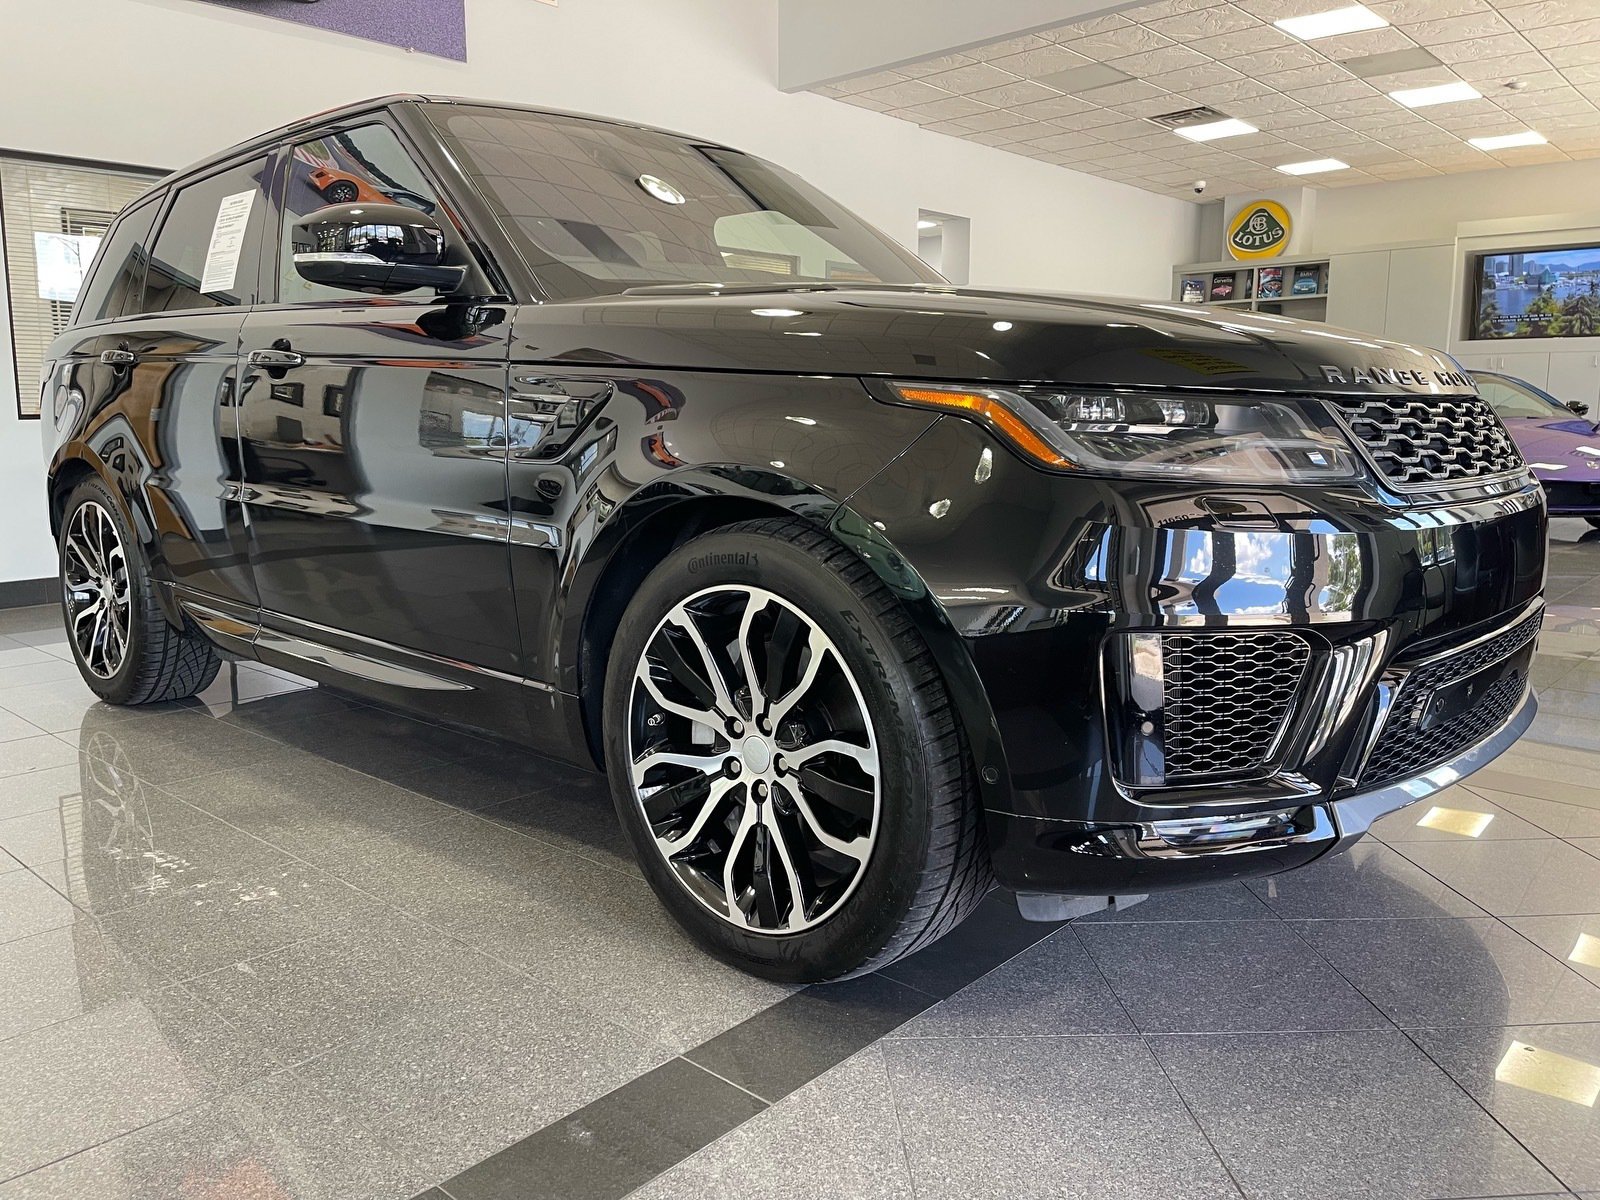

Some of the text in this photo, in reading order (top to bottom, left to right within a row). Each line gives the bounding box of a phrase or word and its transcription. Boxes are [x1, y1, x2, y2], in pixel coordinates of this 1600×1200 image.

[1235, 227, 1283, 246] LOTUS
[1319, 364, 1429, 386] RANGE
[687, 552, 750, 574] Continental
